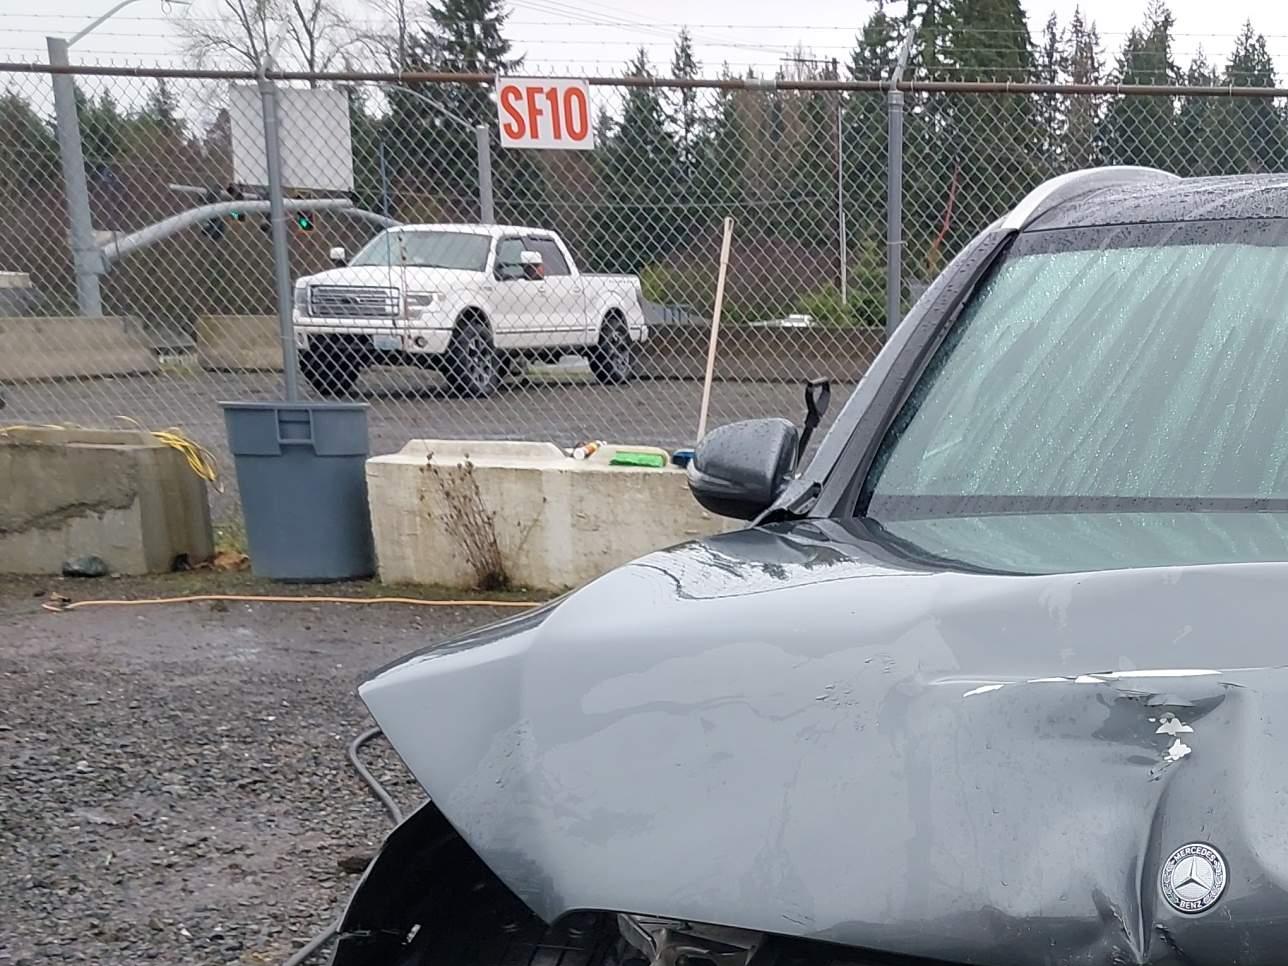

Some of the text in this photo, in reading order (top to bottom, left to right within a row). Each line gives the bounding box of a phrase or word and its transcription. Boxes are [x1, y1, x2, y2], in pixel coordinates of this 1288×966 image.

[500, 84, 589, 142] SF10
[1173, 846, 1216, 862] MERCEDES
[1180, 900, 1203, 909] BENZ
